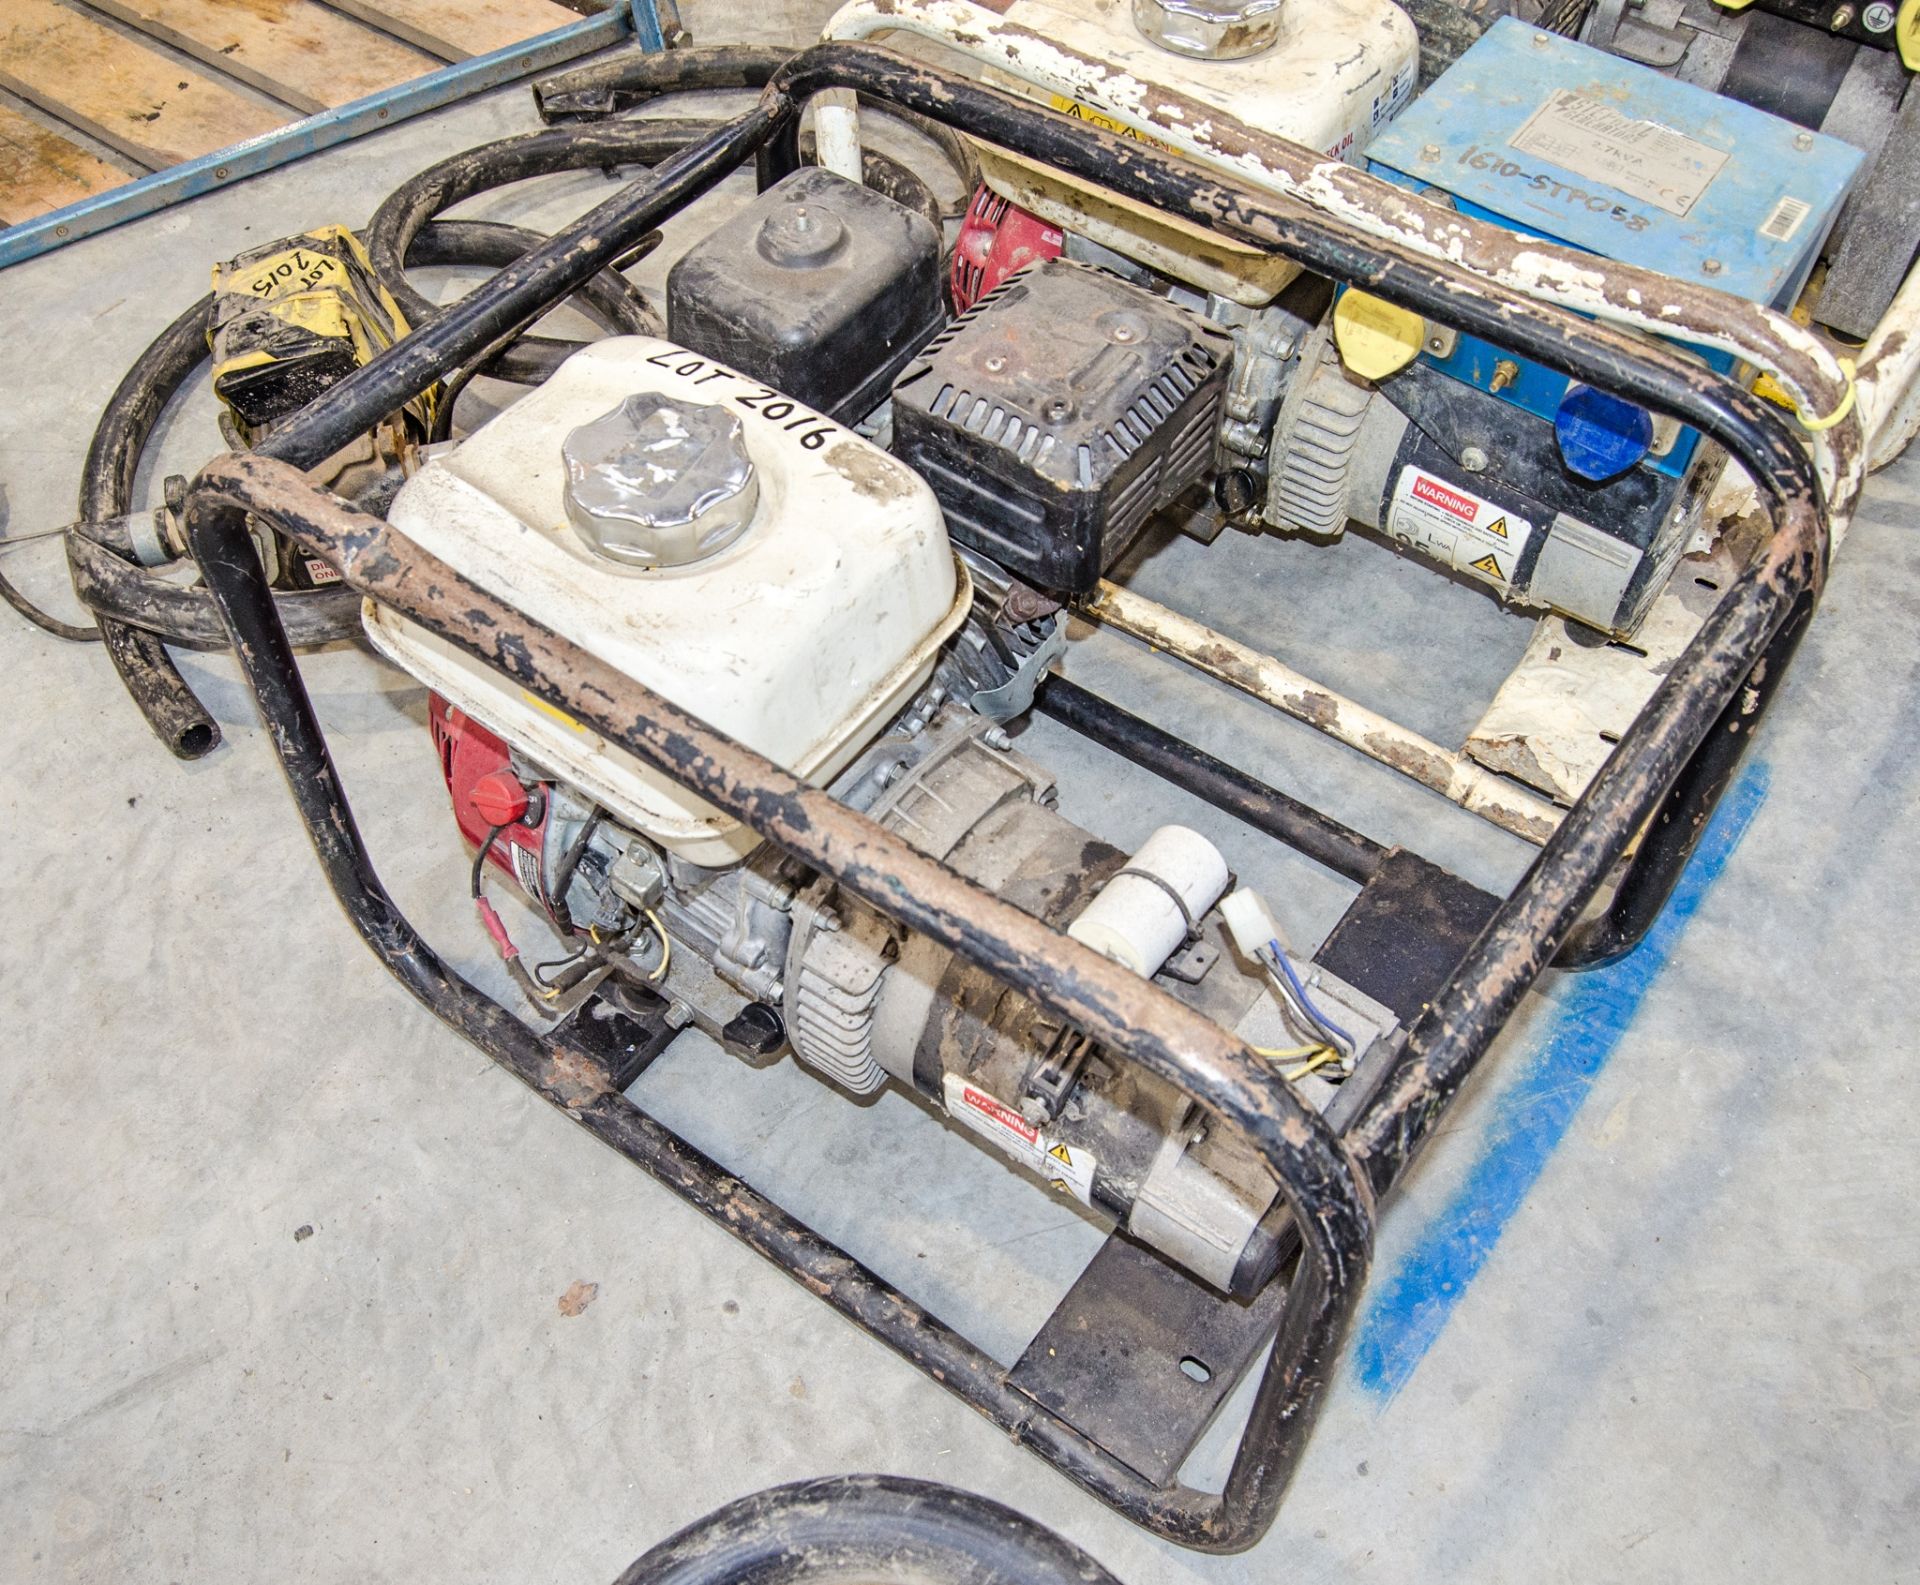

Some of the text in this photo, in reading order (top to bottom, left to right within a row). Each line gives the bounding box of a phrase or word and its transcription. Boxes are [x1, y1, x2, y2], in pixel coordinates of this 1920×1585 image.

[252, 251, 309, 297] 2015
[300, 259, 335, 290] LOT
[646, 350, 837, 450] LOT 2016
[1415, 481, 1475, 517] WARNING
[965, 1092, 1036, 1138] WARNING
